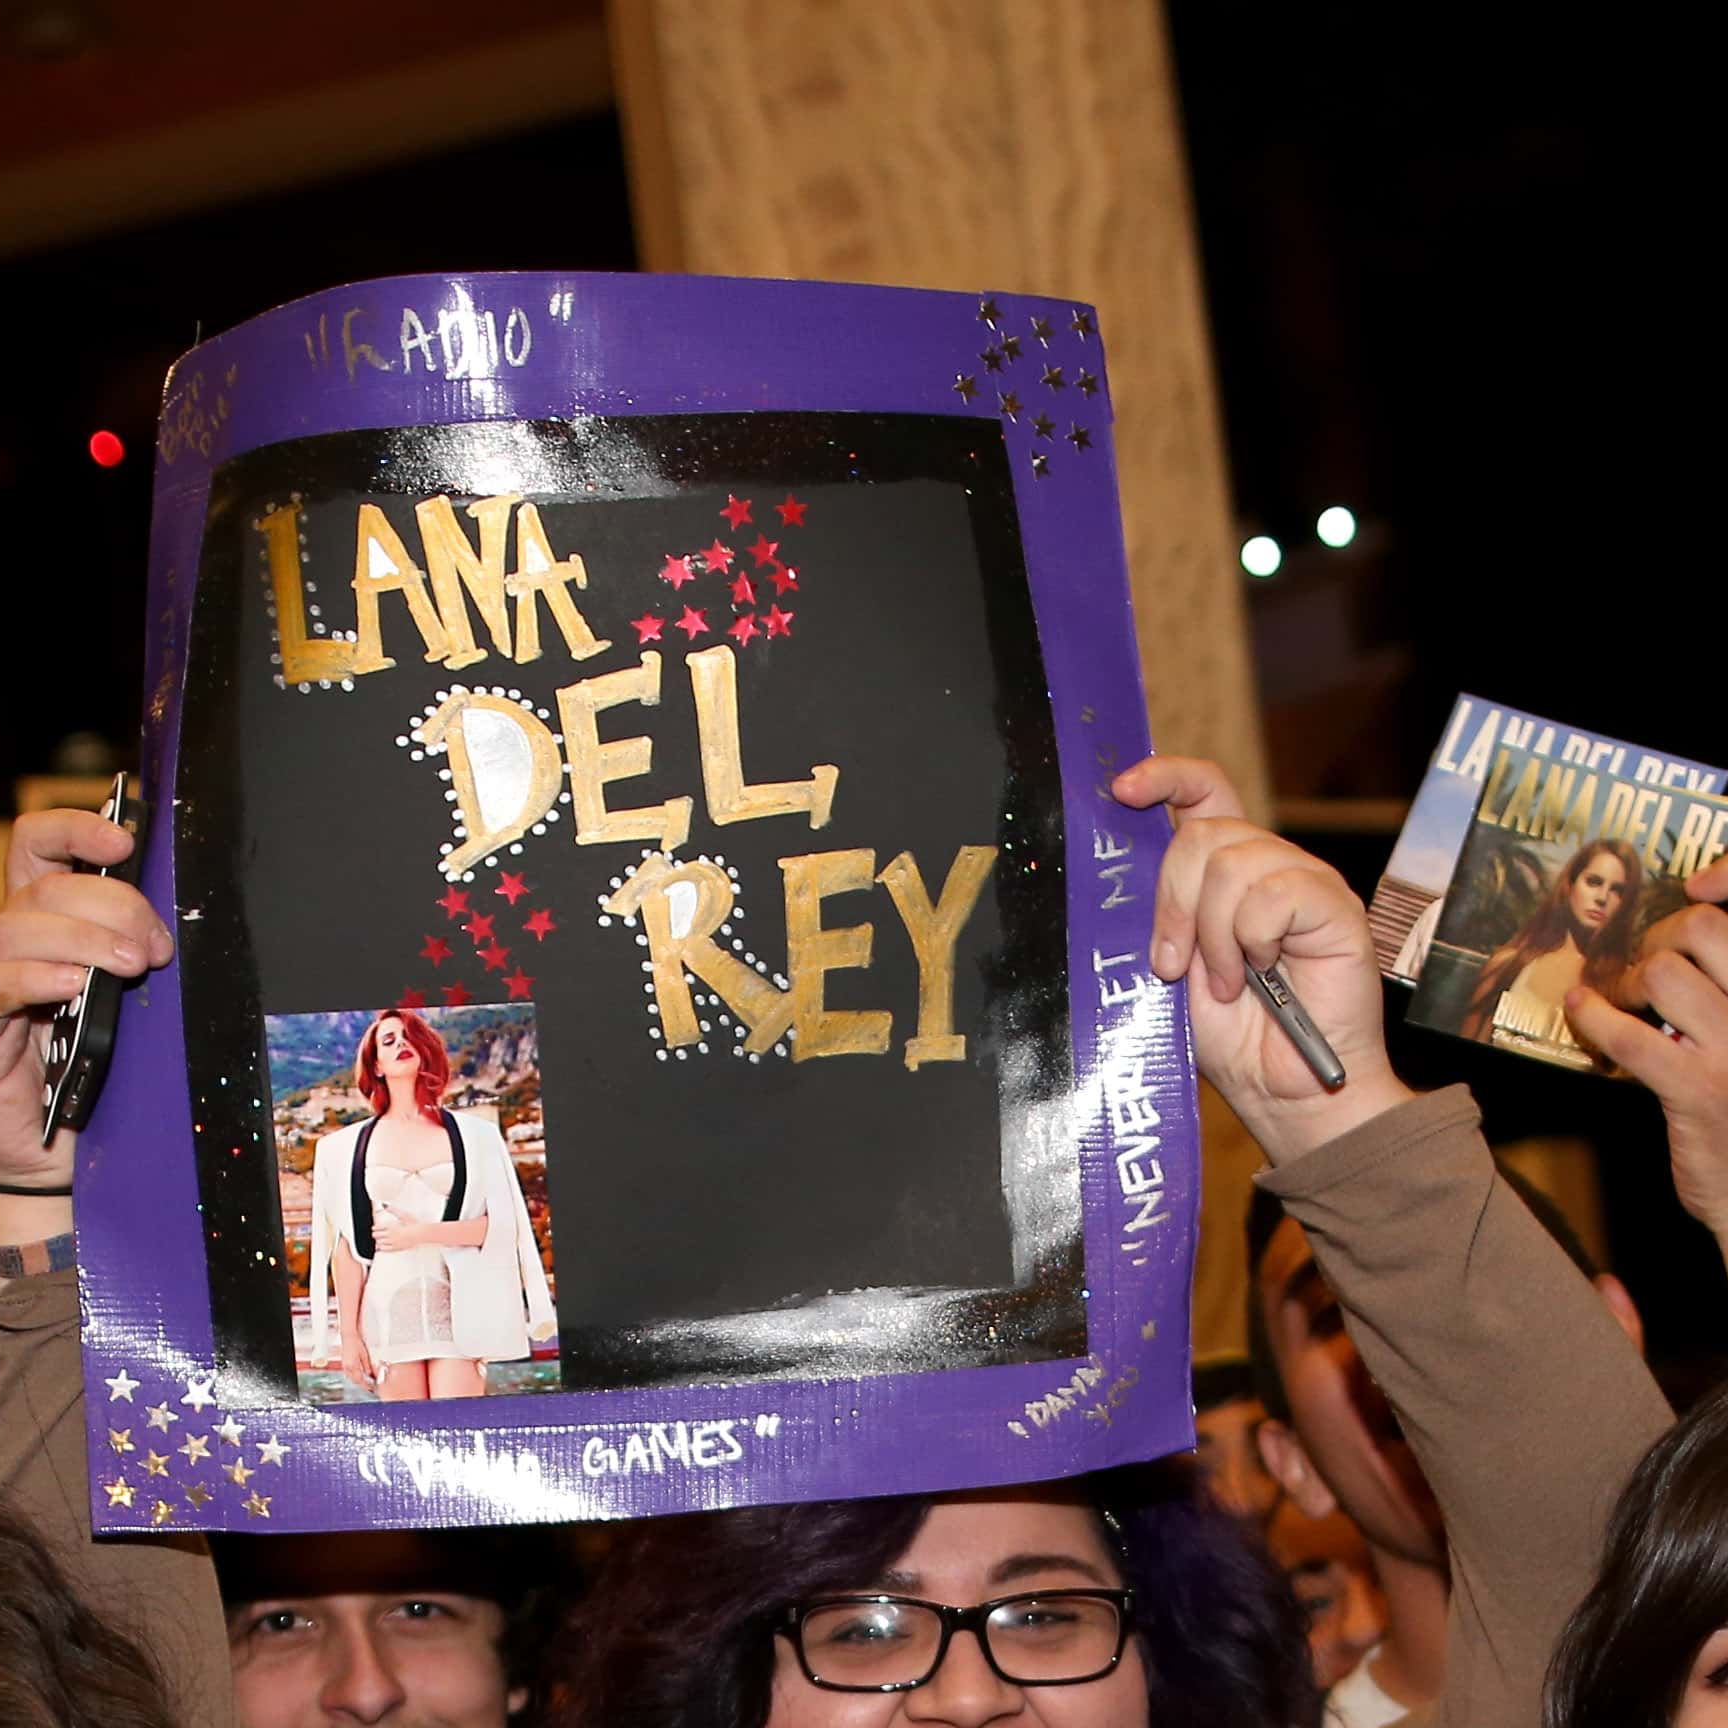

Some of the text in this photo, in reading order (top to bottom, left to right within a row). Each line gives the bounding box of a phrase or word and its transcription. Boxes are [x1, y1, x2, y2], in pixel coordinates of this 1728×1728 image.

[258, 492, 612, 691] LANA
[398, 644, 839, 880] DEL
[1478, 748, 1599, 848] LANA
[1599, 781, 1672, 874] DEL
[598, 844, 997, 1073] REY
[1093, 830, 1136, 909] ME
